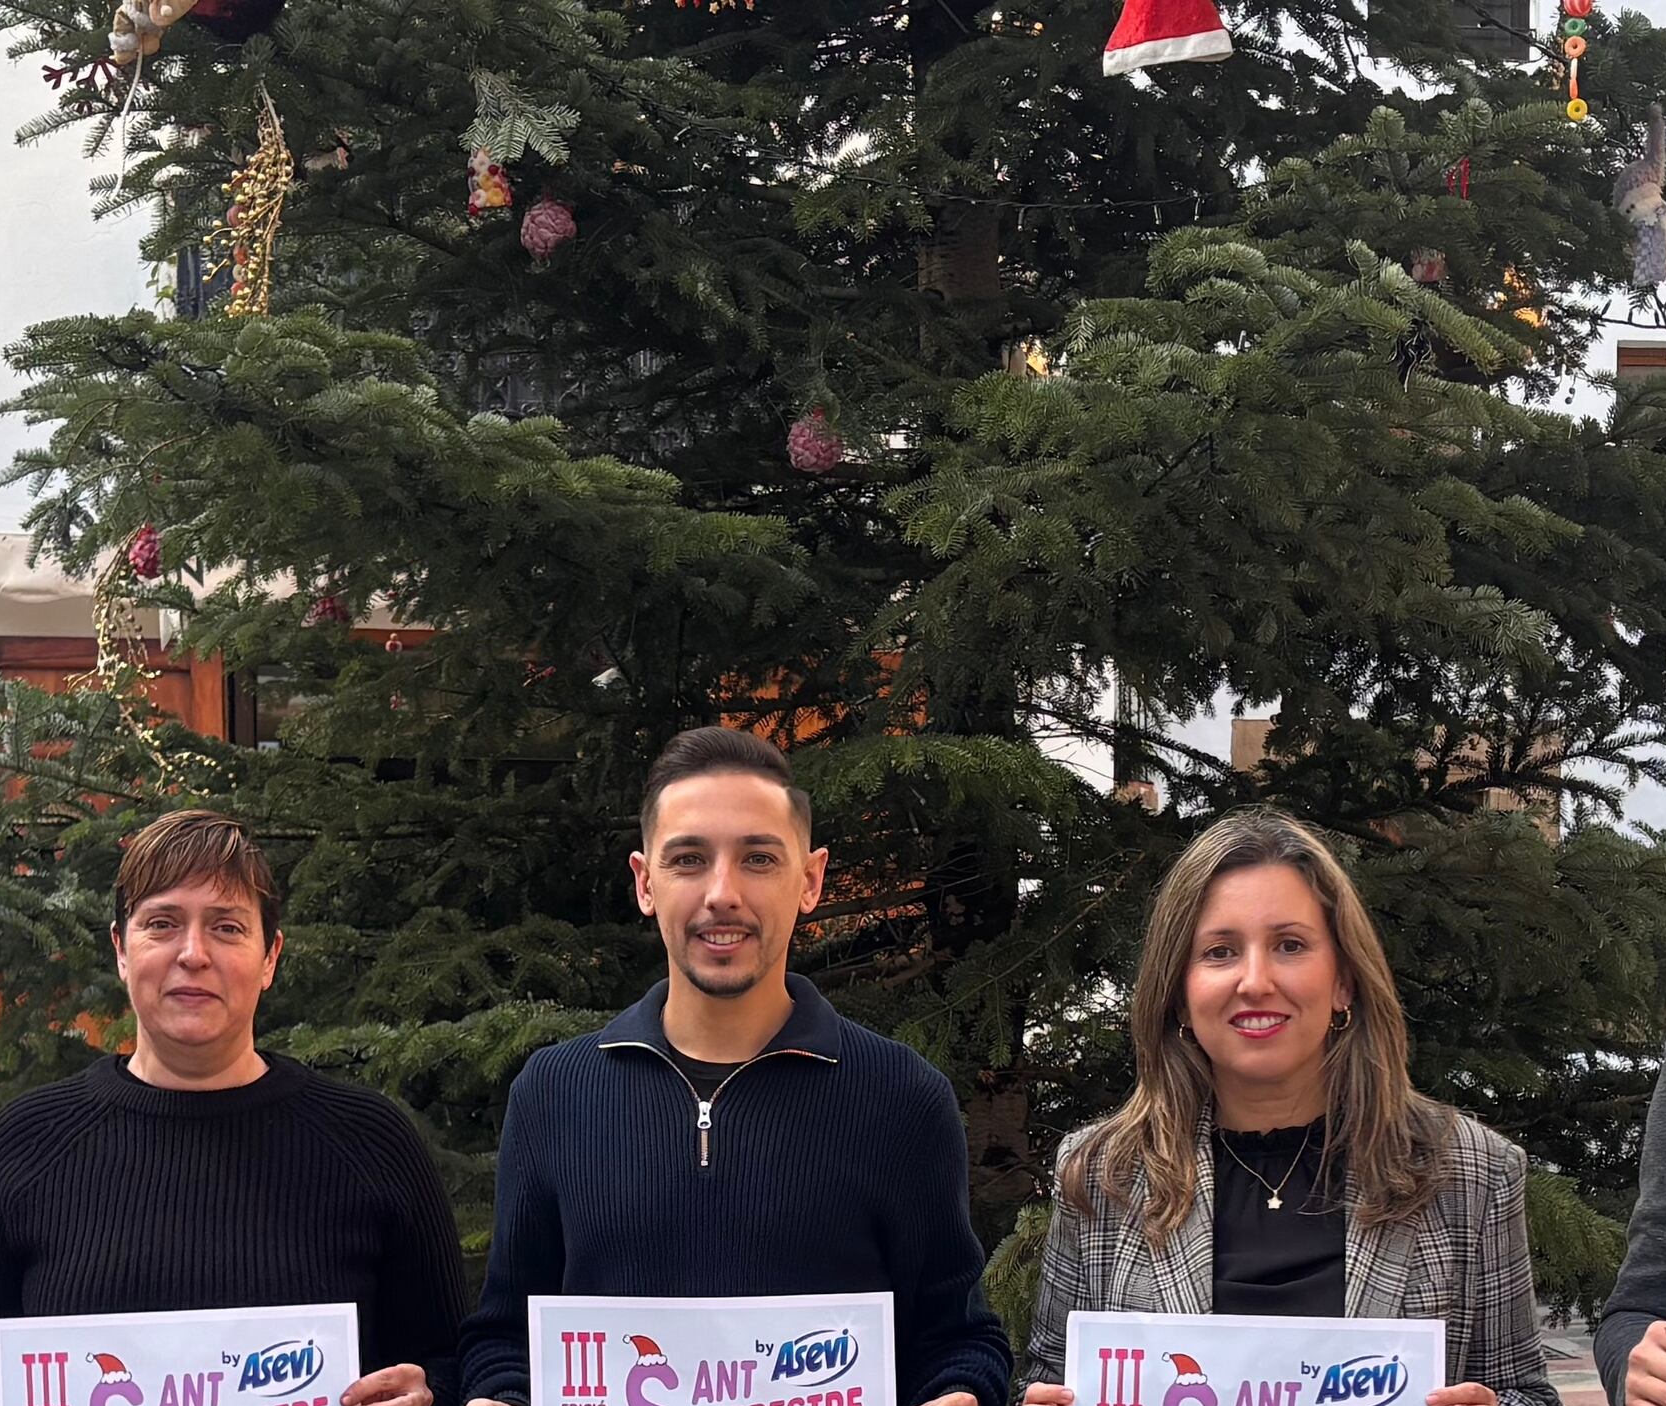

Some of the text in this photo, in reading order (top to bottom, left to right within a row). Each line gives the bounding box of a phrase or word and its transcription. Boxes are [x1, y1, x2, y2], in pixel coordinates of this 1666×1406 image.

[221, 1338, 317, 1393] by Asevi
[561, 1332, 607, 1396] III
[755, 1329, 849, 1379] by Asevi
[1300, 1353, 1399, 1406] by Asevi
